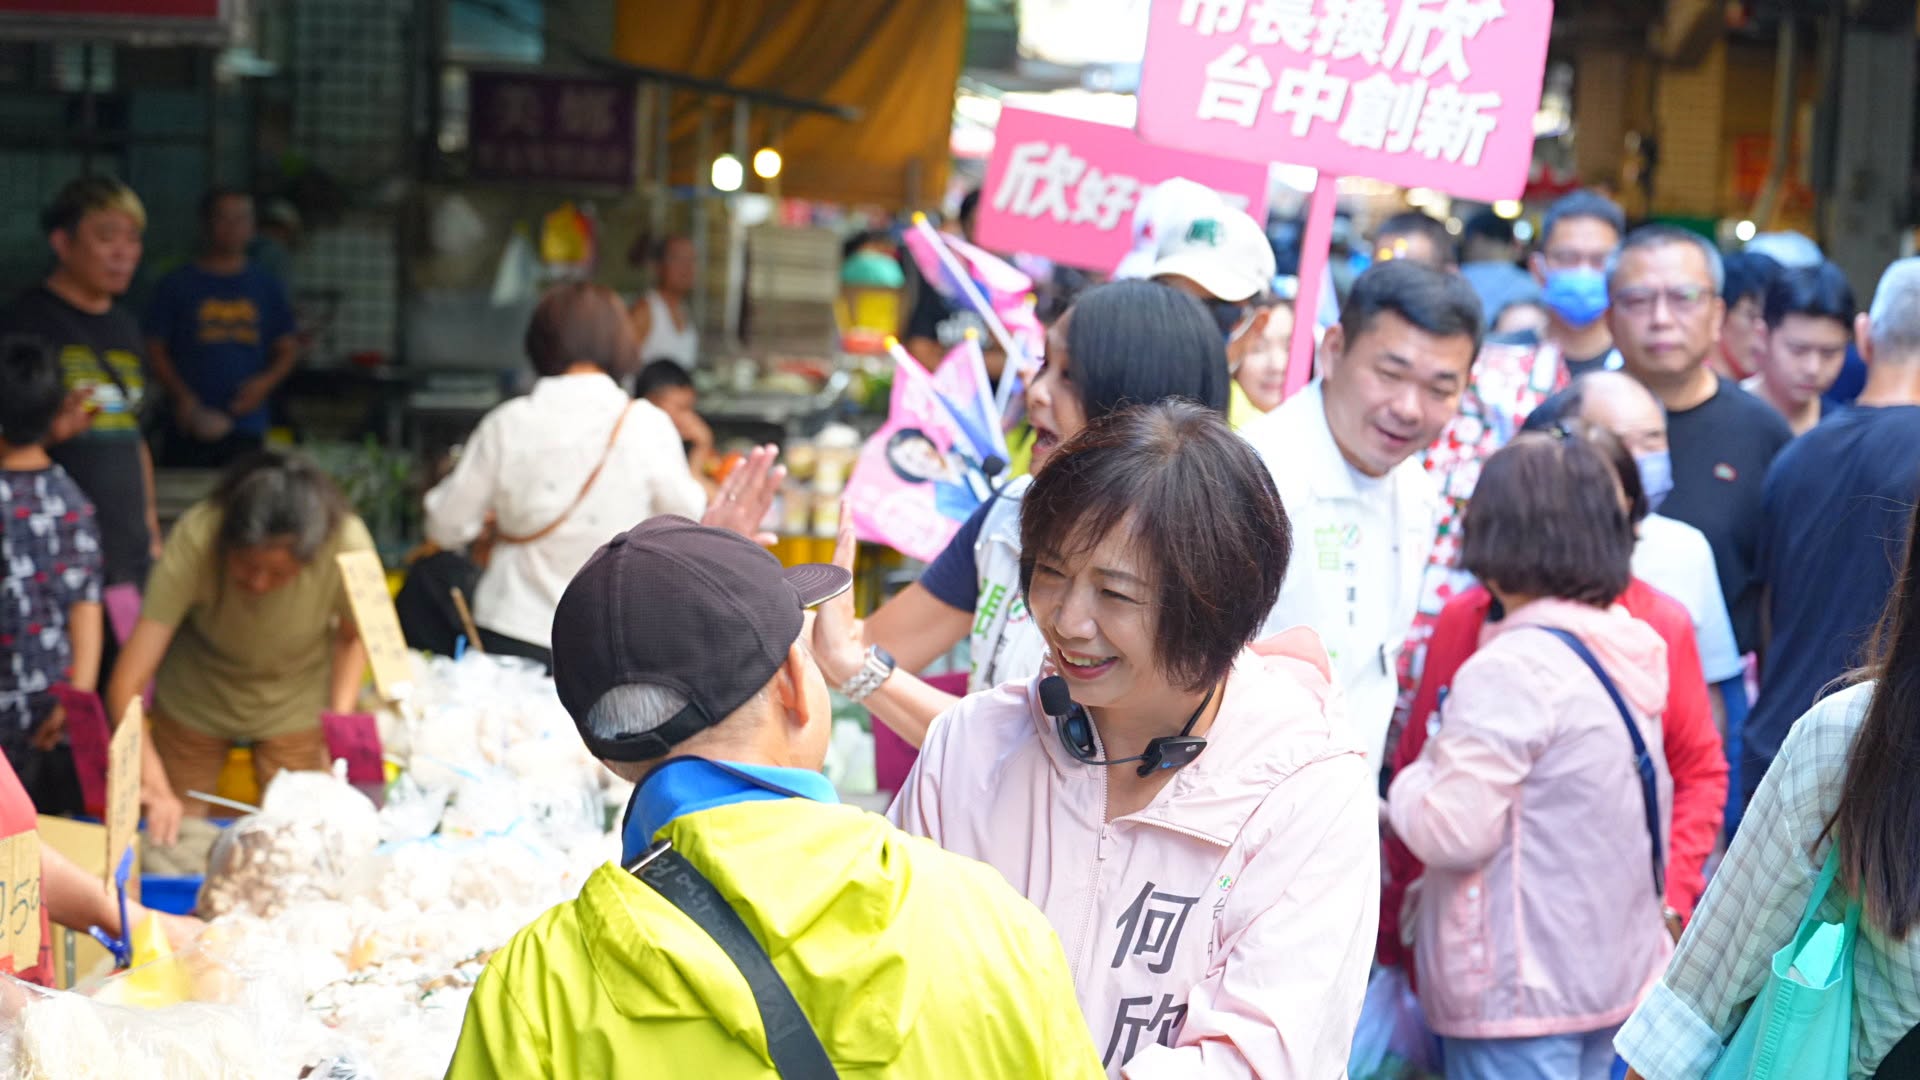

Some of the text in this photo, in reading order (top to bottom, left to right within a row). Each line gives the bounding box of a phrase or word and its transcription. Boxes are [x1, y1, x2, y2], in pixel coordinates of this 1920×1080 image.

[1197, 43, 1502, 167] 台中創新
[1102, 881, 1200, 1070] 何欣
